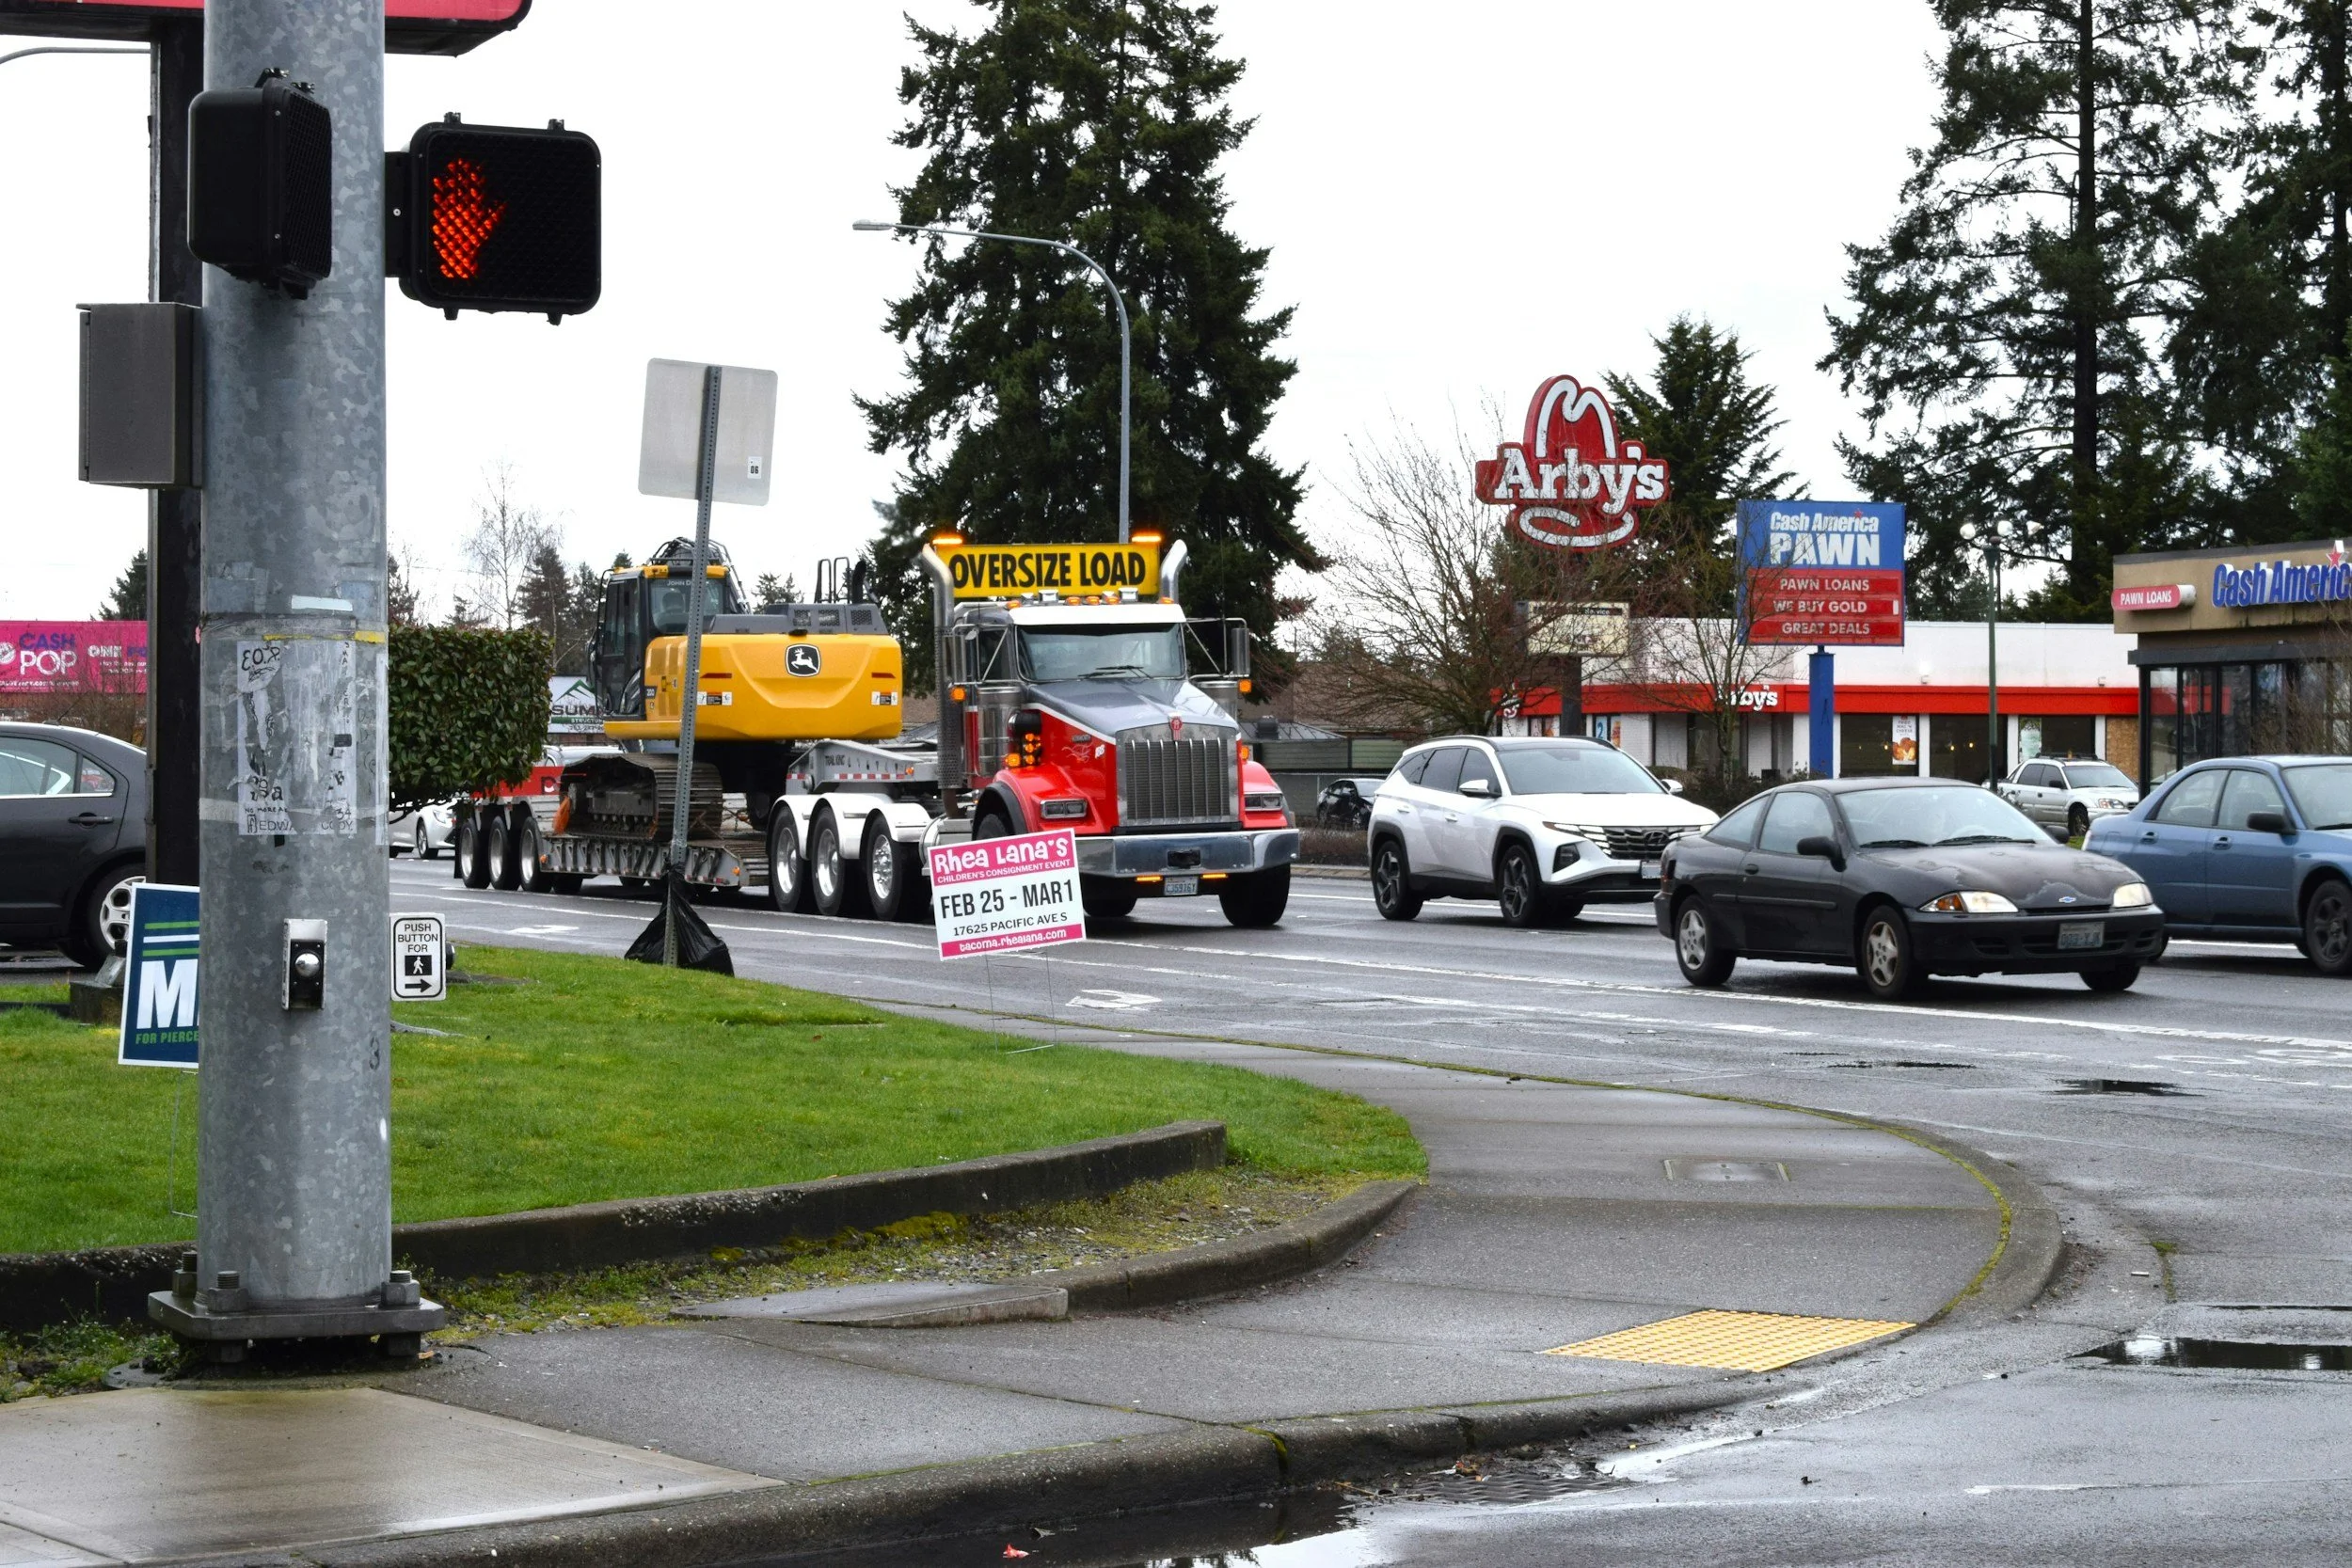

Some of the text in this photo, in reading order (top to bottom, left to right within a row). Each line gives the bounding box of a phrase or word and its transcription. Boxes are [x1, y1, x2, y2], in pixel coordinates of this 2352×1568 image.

[1494, 446, 1664, 515] Arby's
[1770, 512, 1880, 532] Cash America
[1770, 532, 1880, 565] PAWN
[949, 551, 1147, 590] OVERSIZE LOAD
[1779, 578, 1870, 592] PAWN LOANS
[2213, 560, 2352, 609] Cash Americ
[1772, 600, 1867, 613] WE BUY GOLD
[2120, 590, 2172, 606] PAWN LOANS
[1782, 623, 1870, 635] GREAT DEALS
[19, 632, 76, 651] CASH
[20, 650, 77, 675] POP
[934, 848, 990, 875] Rhea
[937, 858, 1071, 884] CHILDREN'S CONSIGNMENT EVENT
[940, 893, 976, 919] FEB
[979, 888, 1005, 914] 25
[404, 923, 432, 932] PUSH
[953, 911, 1069, 937] 17625 PACIFIC AVE S
[397, 933, 438, 942] BUTTON
[407, 944, 428, 953] FOR
[136, 958, 199, 1030] M
[135, 1030, 199, 1045] FOR PIERCE
